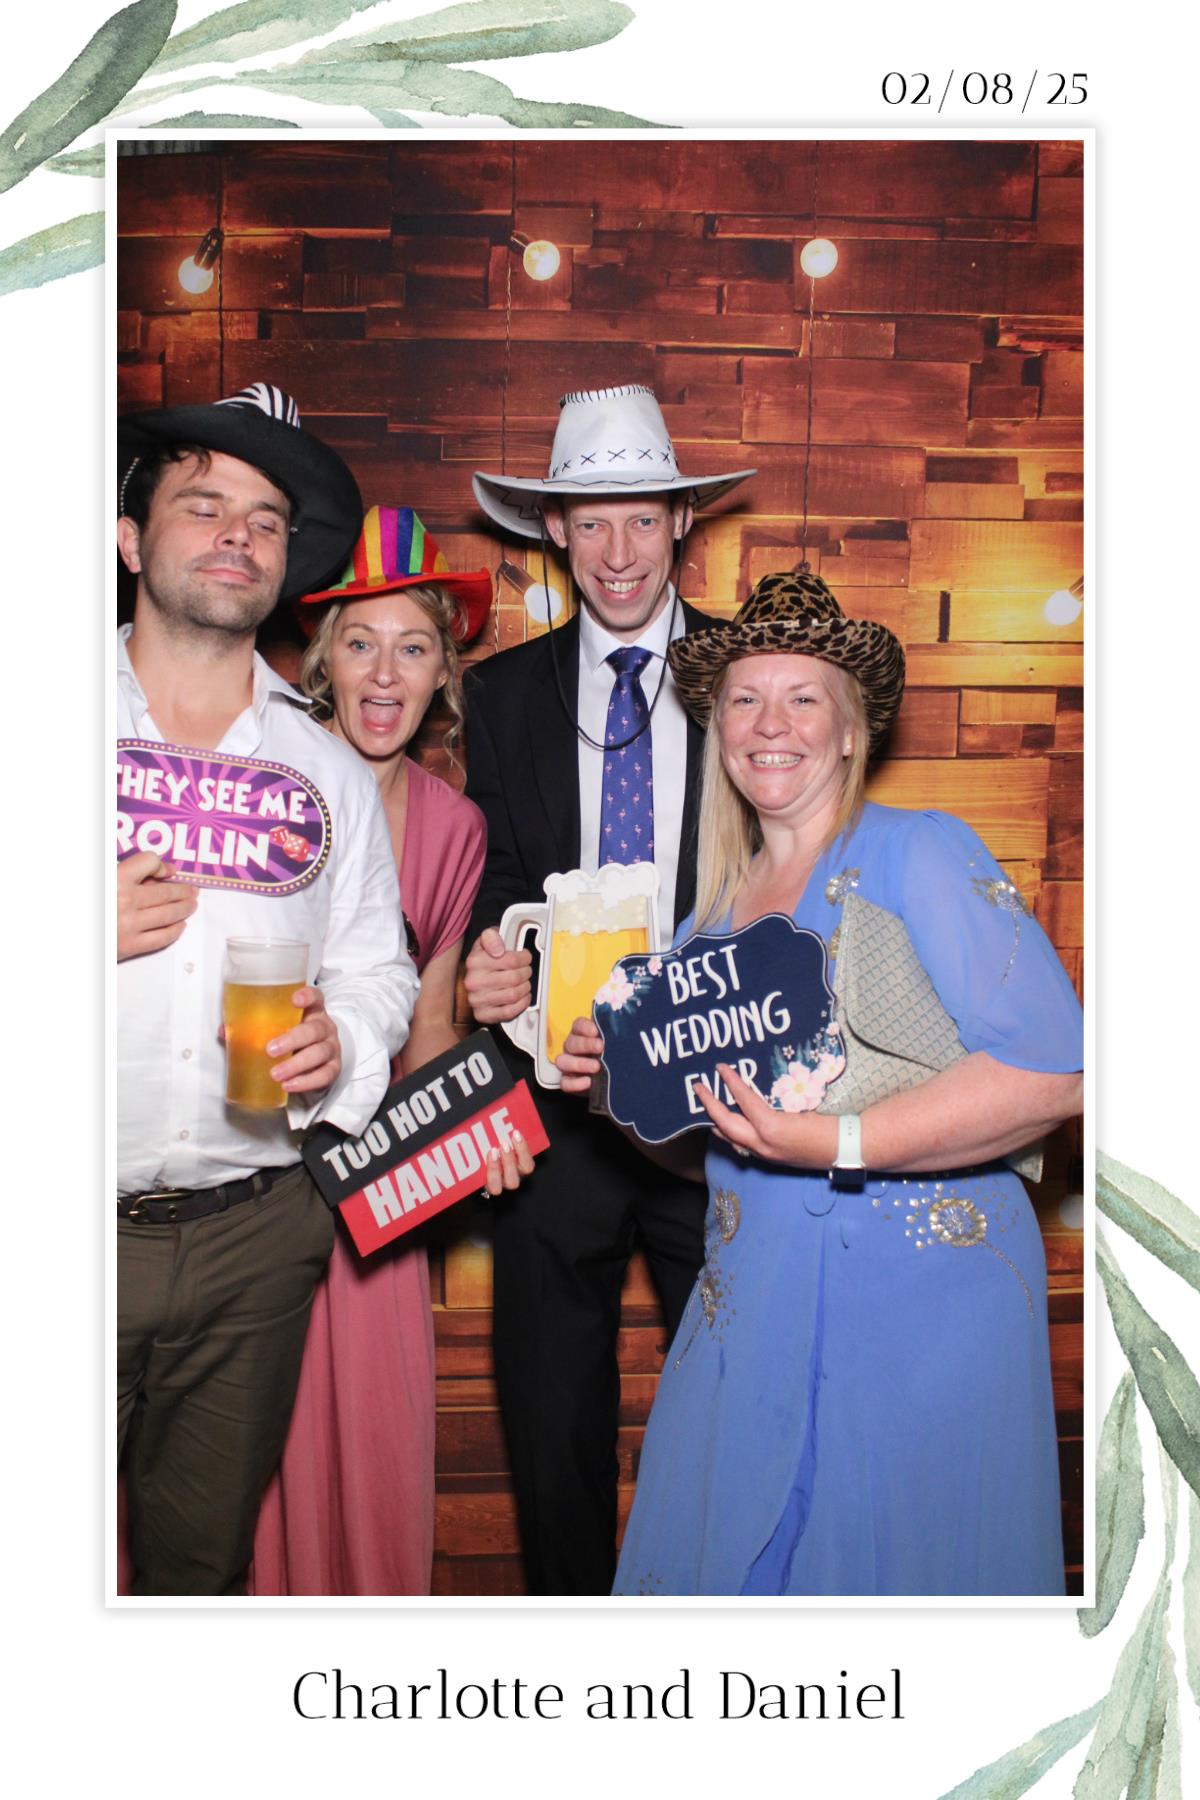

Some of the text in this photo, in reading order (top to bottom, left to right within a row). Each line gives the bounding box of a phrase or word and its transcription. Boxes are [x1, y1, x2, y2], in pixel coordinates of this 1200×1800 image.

[117, 763, 307, 824] HEY SEE ME
[667, 944, 741, 1005] BEST
[640, 991, 791, 1067] WEDDING
[321, 1051, 494, 1182] TOO HOT TO
